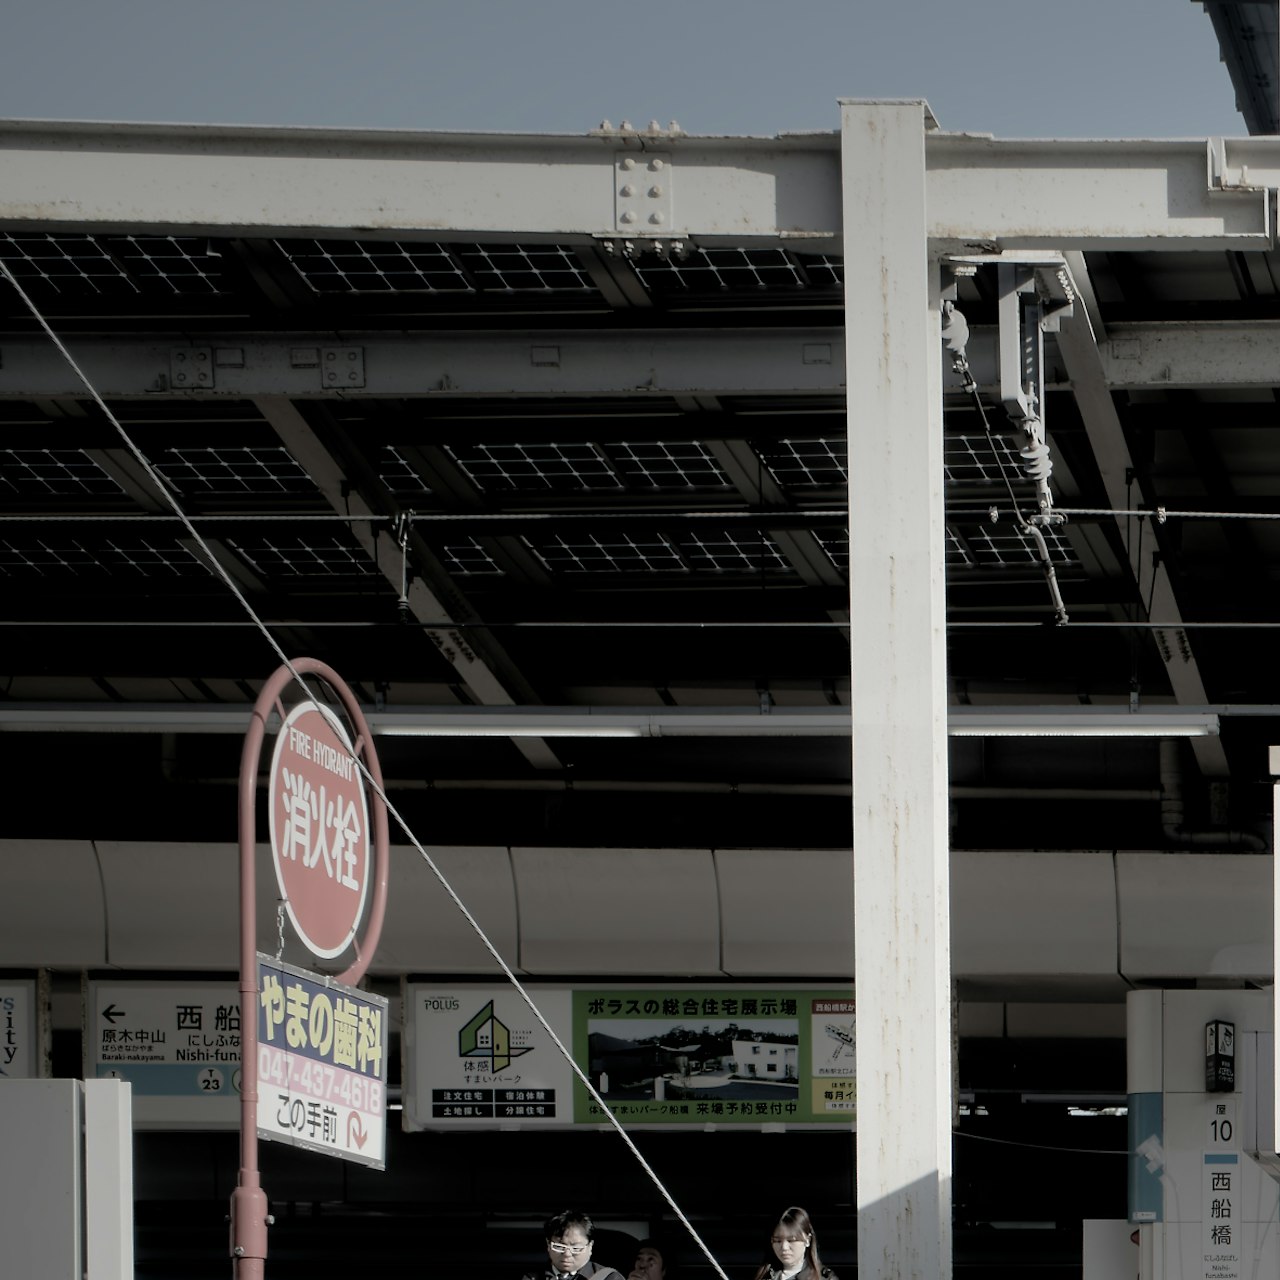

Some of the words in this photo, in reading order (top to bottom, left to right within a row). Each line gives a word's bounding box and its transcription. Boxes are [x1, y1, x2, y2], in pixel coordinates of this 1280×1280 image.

[290, 727, 311, 760] FIRE
[313, 739, 354, 783] HYDRANT
[282, 767, 360, 892] 消火栓
[425, 1000, 460, 1010] POLUS
[588, 998, 798, 1015] ポラスの総合住宅展示場
[261, 975, 383, 1077] やまの歯科
[103, 1029, 166, 1044] 原木中山
[464, 1060, 489, 1072] 体感
[202, 1081, 220, 1090] 23
[259, 1048, 382, 1115] 047-437-4618
[464, 1074, 521, 1083] すまいパーク
[443, 1091, 483, 1100] 注文住宅
[506, 1091, 545, 1100] 宿泊体験
[443, 1107, 483, 1115] 土地探し
[697, 1104, 797, 1115] 来場予約受付中
[277, 1094, 338, 1143] この手前
[1211, 1120, 1233, 1142] 10
[1211, 1172, 1232, 1245] 西船橋
